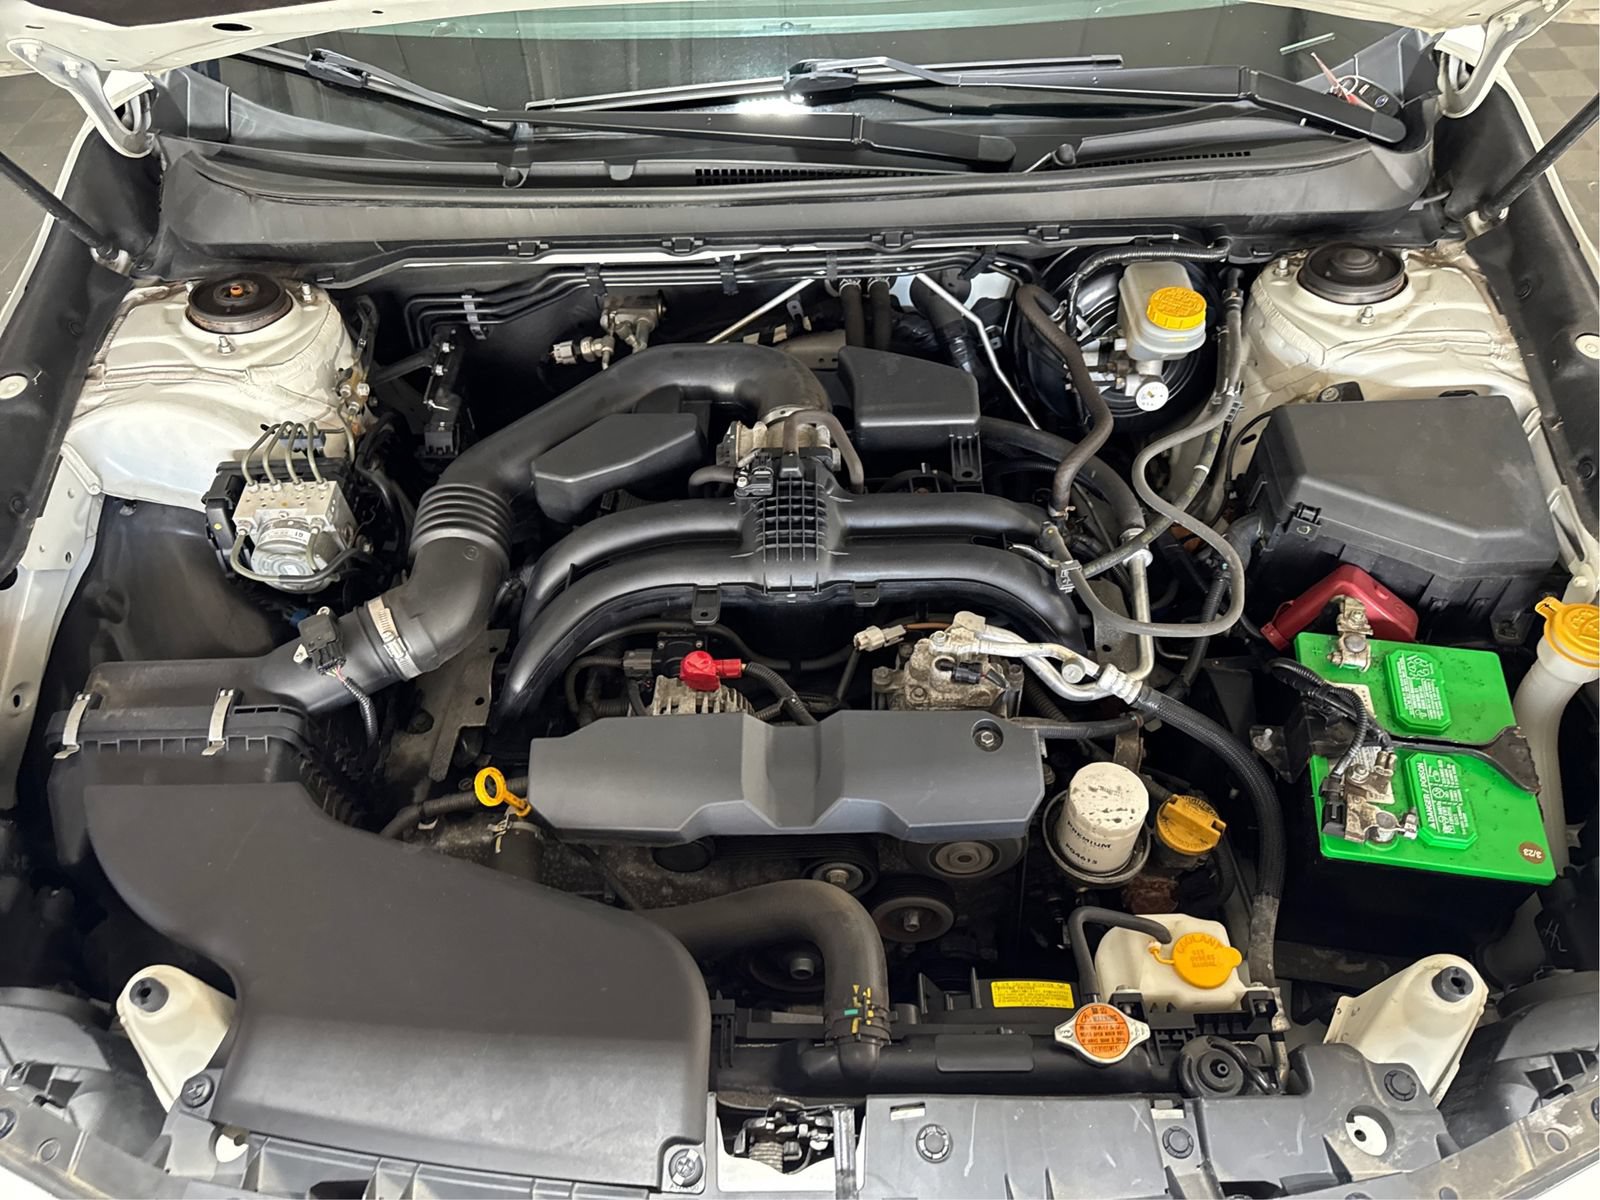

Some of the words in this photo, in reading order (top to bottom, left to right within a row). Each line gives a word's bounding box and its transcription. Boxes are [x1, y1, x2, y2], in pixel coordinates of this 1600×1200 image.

[1416, 762, 1429, 788] POISON
[1423, 793, 1437, 823] DANGER
[1067, 820, 1111, 849] PREMIUM
[1522, 848, 1543, 859] 3/23
[1175, 934, 1220, 954] COOLANT
